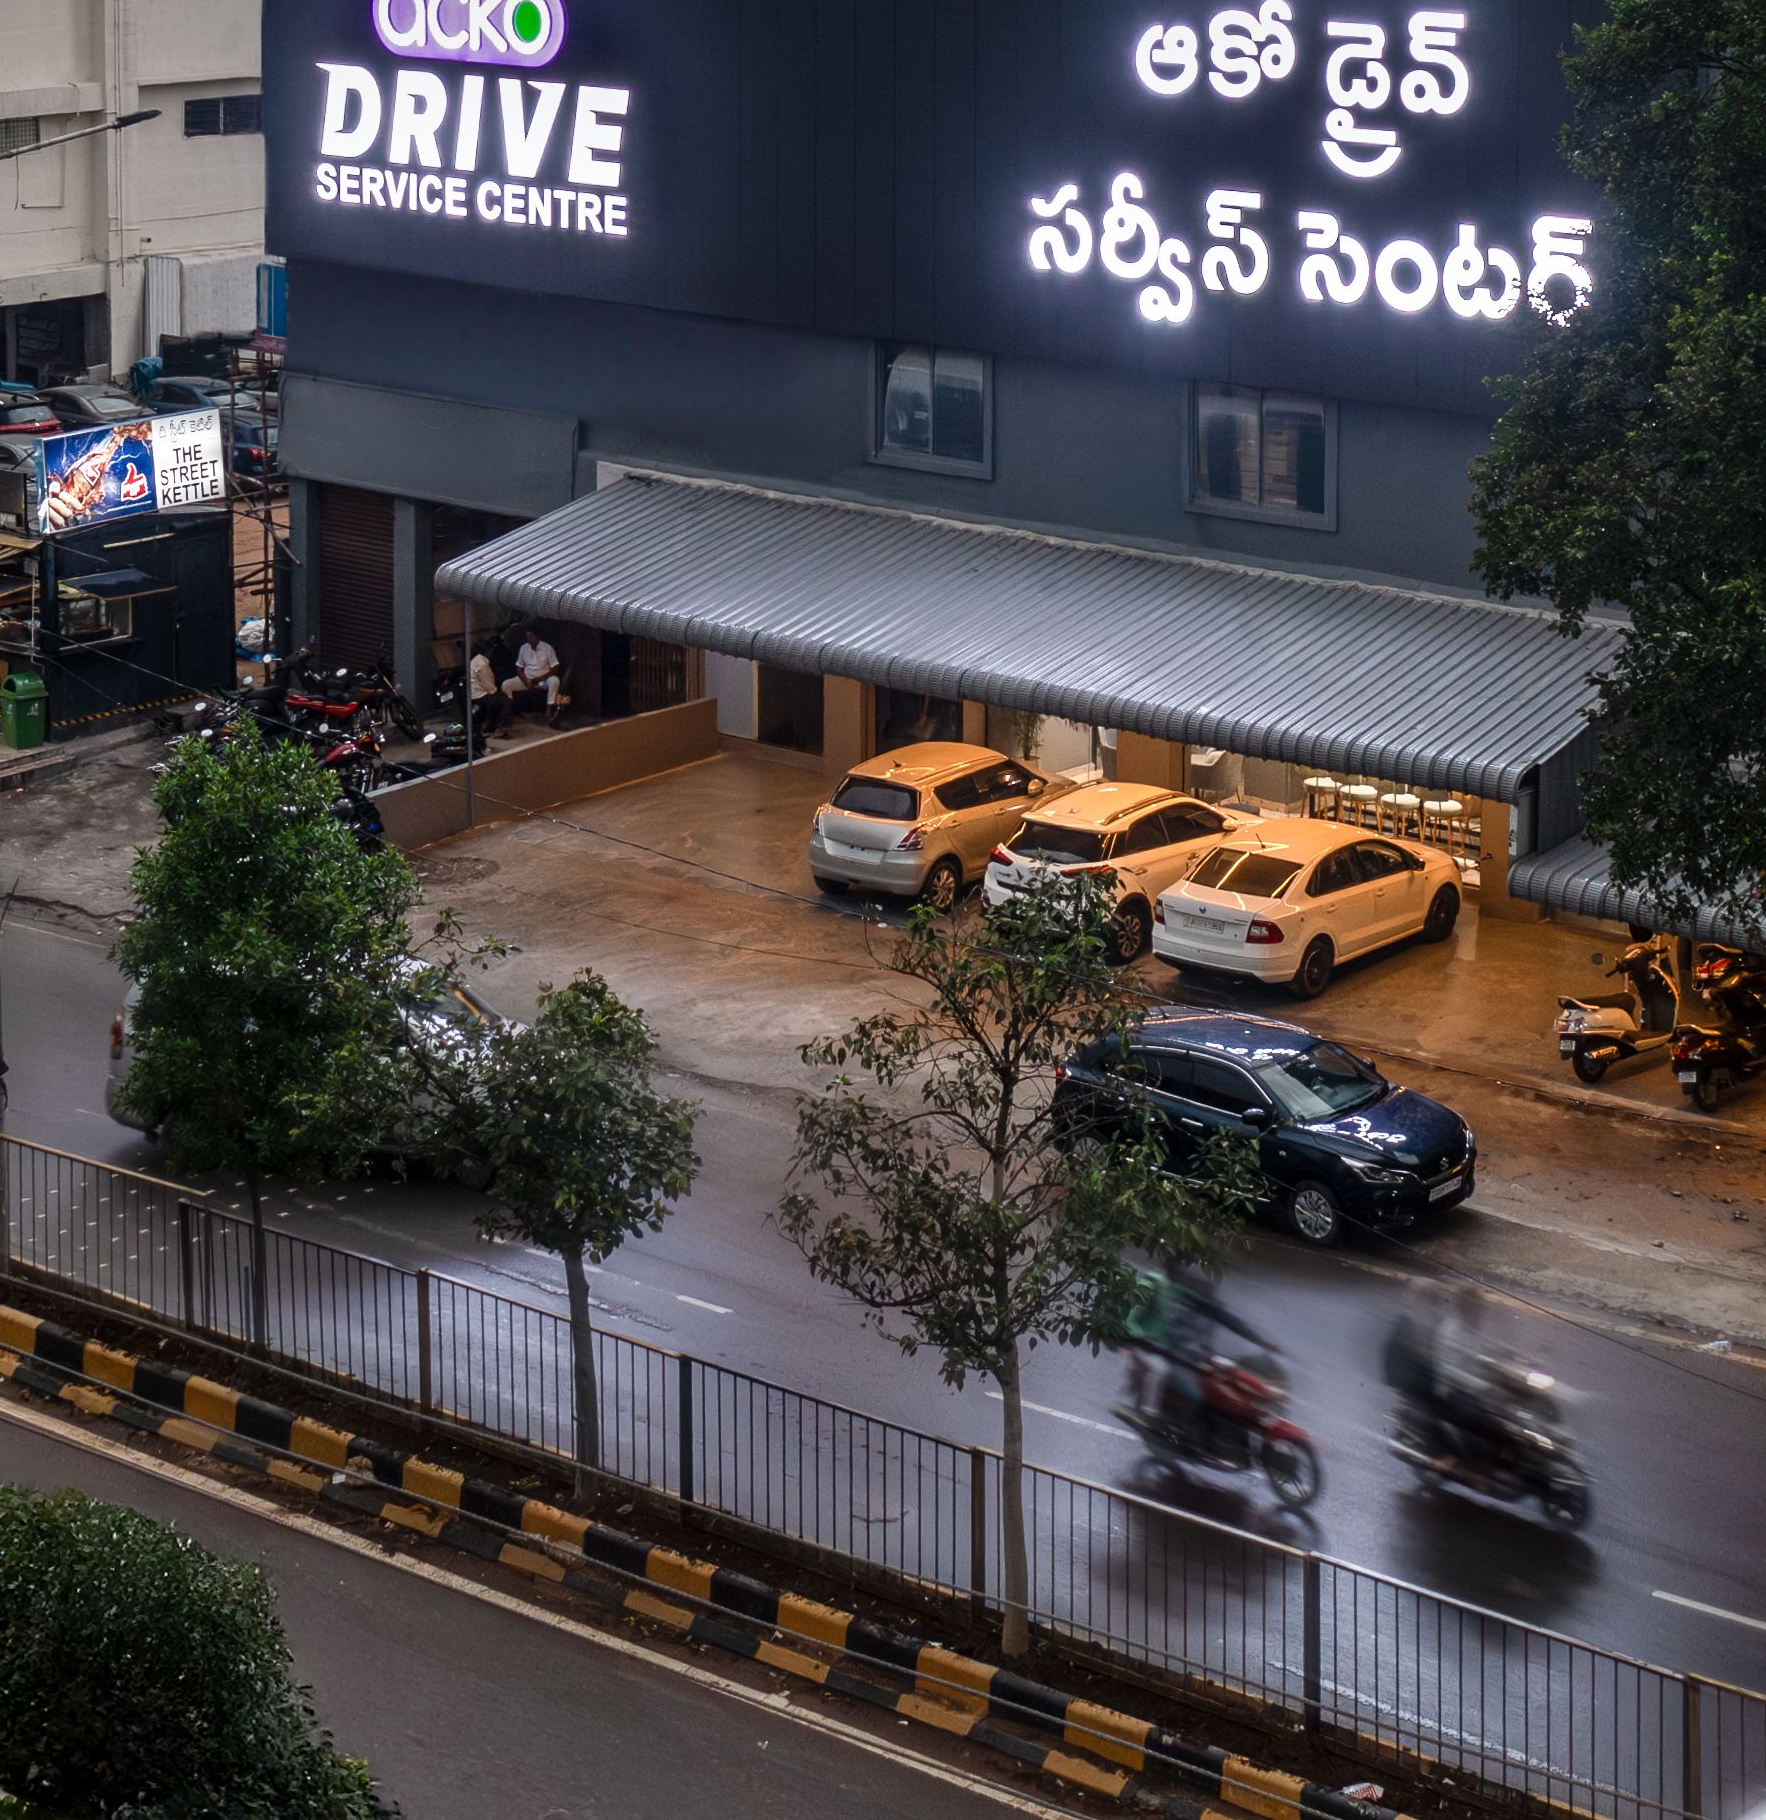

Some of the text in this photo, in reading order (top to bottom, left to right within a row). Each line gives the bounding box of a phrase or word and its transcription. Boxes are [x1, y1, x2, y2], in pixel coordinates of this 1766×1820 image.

[315, 62, 631, 188] DRIVE
[1321, 11, 1470, 178] డ్రైవ్
[315, 162, 629, 237] SERVICE CENTRE
[1029, 171, 1271, 324] సర్వీస్
[160, 459, 218, 486] STREET
[161, 478, 220, 506] KETTLE
[172, 444, 203, 465] THE
